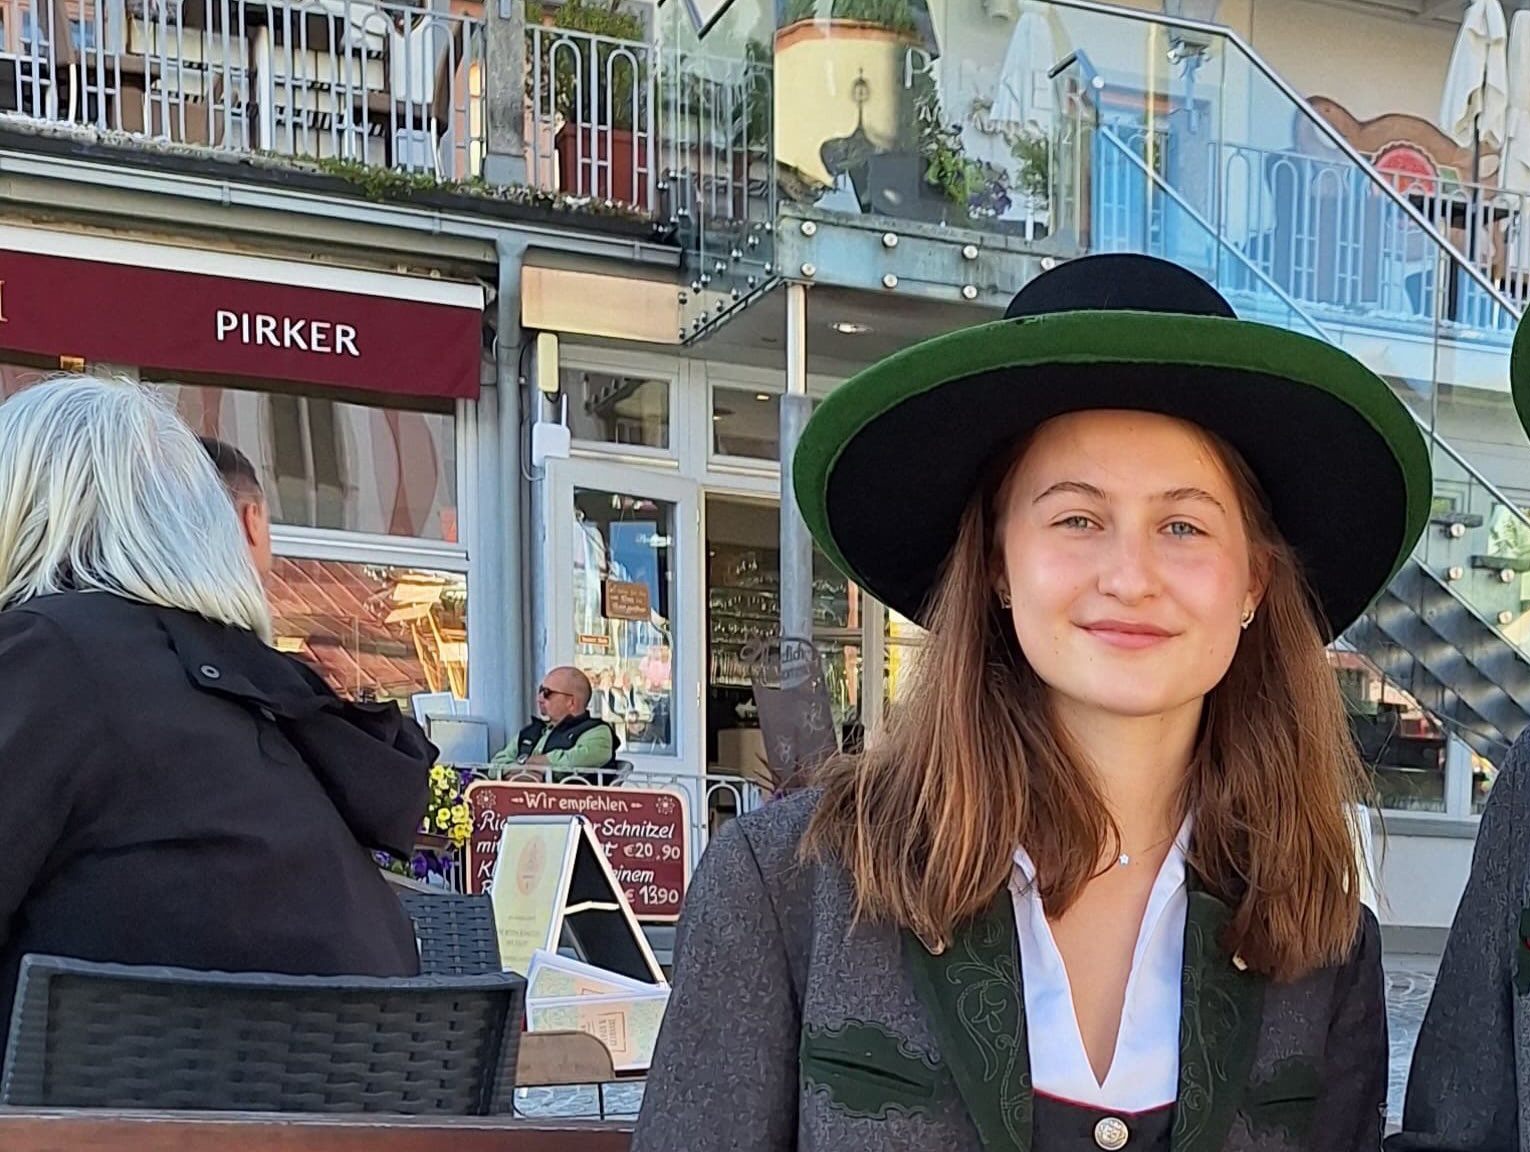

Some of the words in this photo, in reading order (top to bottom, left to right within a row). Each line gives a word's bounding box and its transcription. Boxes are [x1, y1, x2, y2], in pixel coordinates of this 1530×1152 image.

[215, 309, 360, 356] PIRKER
[523, 790, 557, 809] Wir
[559, 795, 629, 813] empfehlen
[602, 818, 675, 839] Schnitzel
